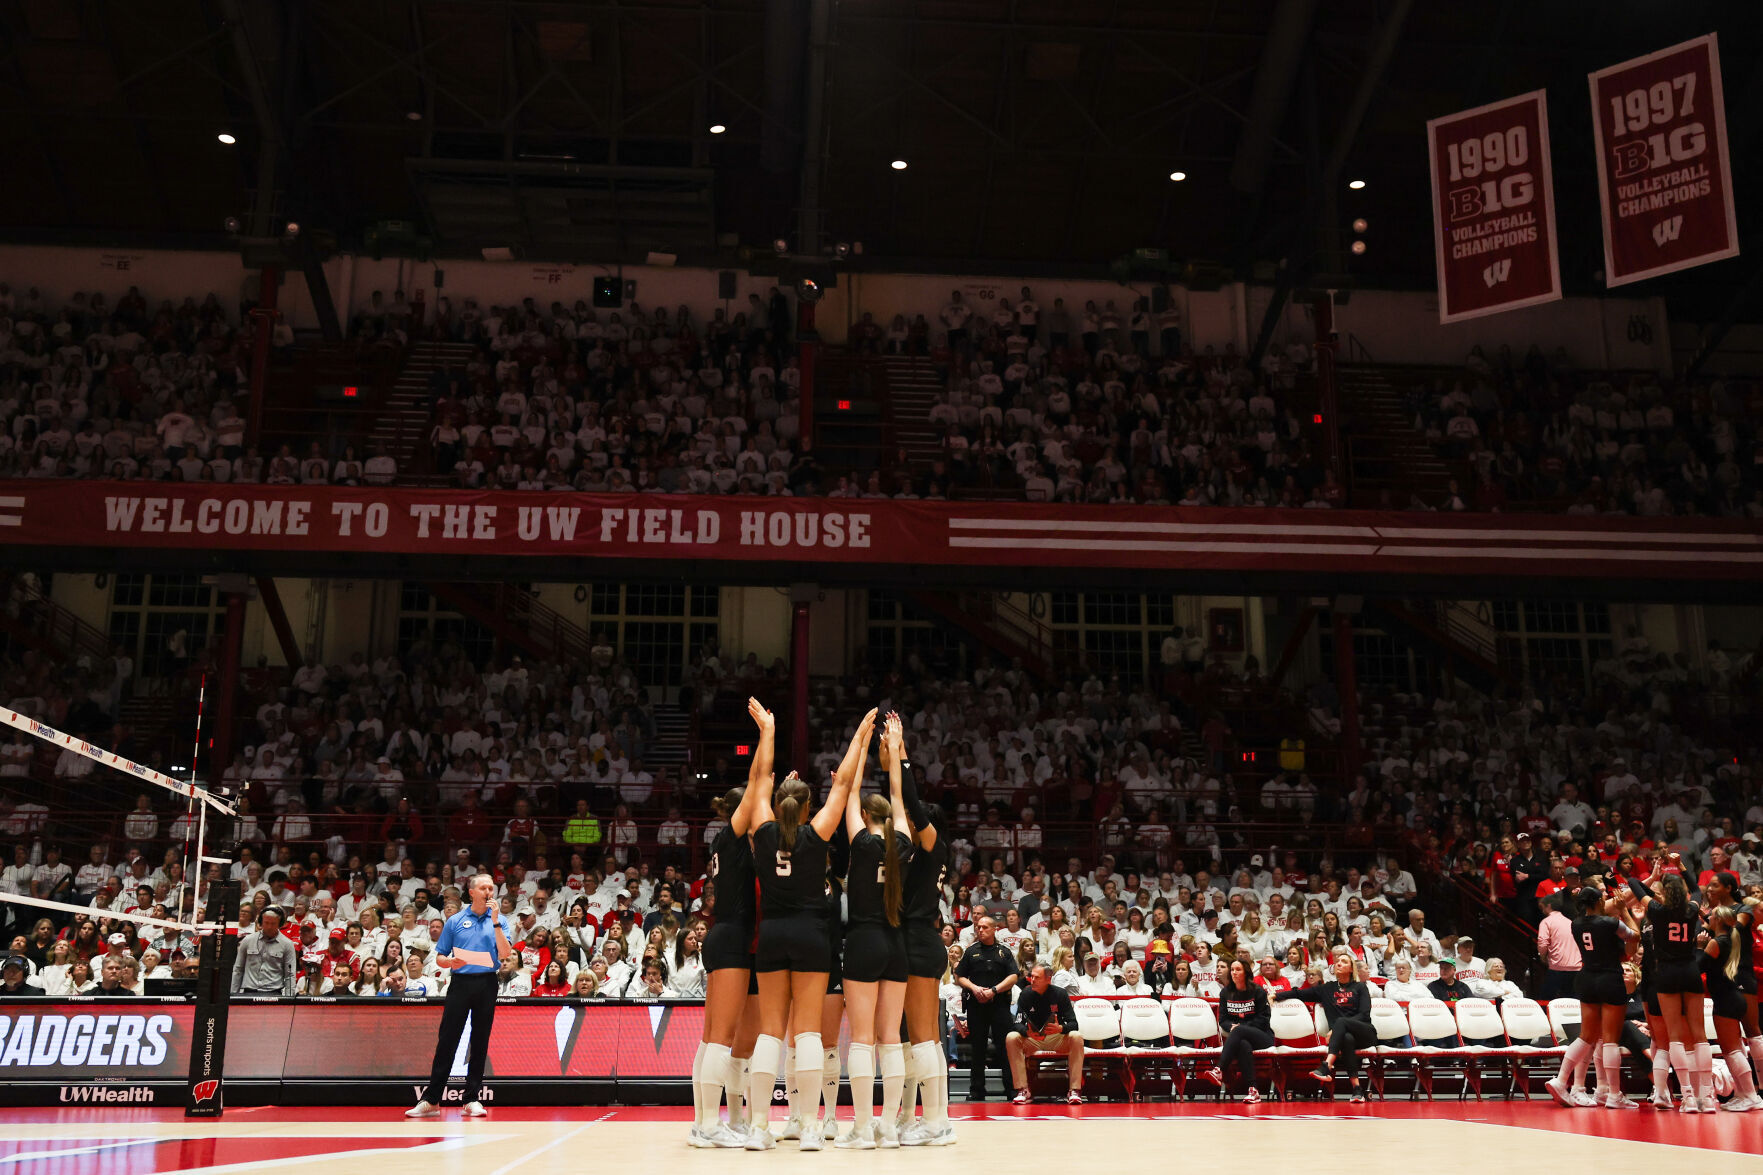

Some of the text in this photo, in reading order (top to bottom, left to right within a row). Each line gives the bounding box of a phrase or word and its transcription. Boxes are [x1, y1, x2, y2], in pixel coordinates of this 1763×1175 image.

[1610, 71, 1698, 137] 1997
[1447, 125, 1529, 182] 1990
[1616, 163, 1710, 201] VOLLEYBALL
[1617, 178, 1711, 219] CHAMPIONS
[1451, 211, 1537, 242] VOLLEYBALL
[1452, 226, 1538, 260] CHAMPIONS
[105, 496, 871, 548] WELCOME TO THE UW FIELD HOUSE
[775, 849, 793, 877] 5
[1581, 931, 1595, 952] 9
[1668, 922, 1689, 943] 21
[203, 1017, 215, 1076] sports imports
[59, 1086, 154, 1102] UWHealth
